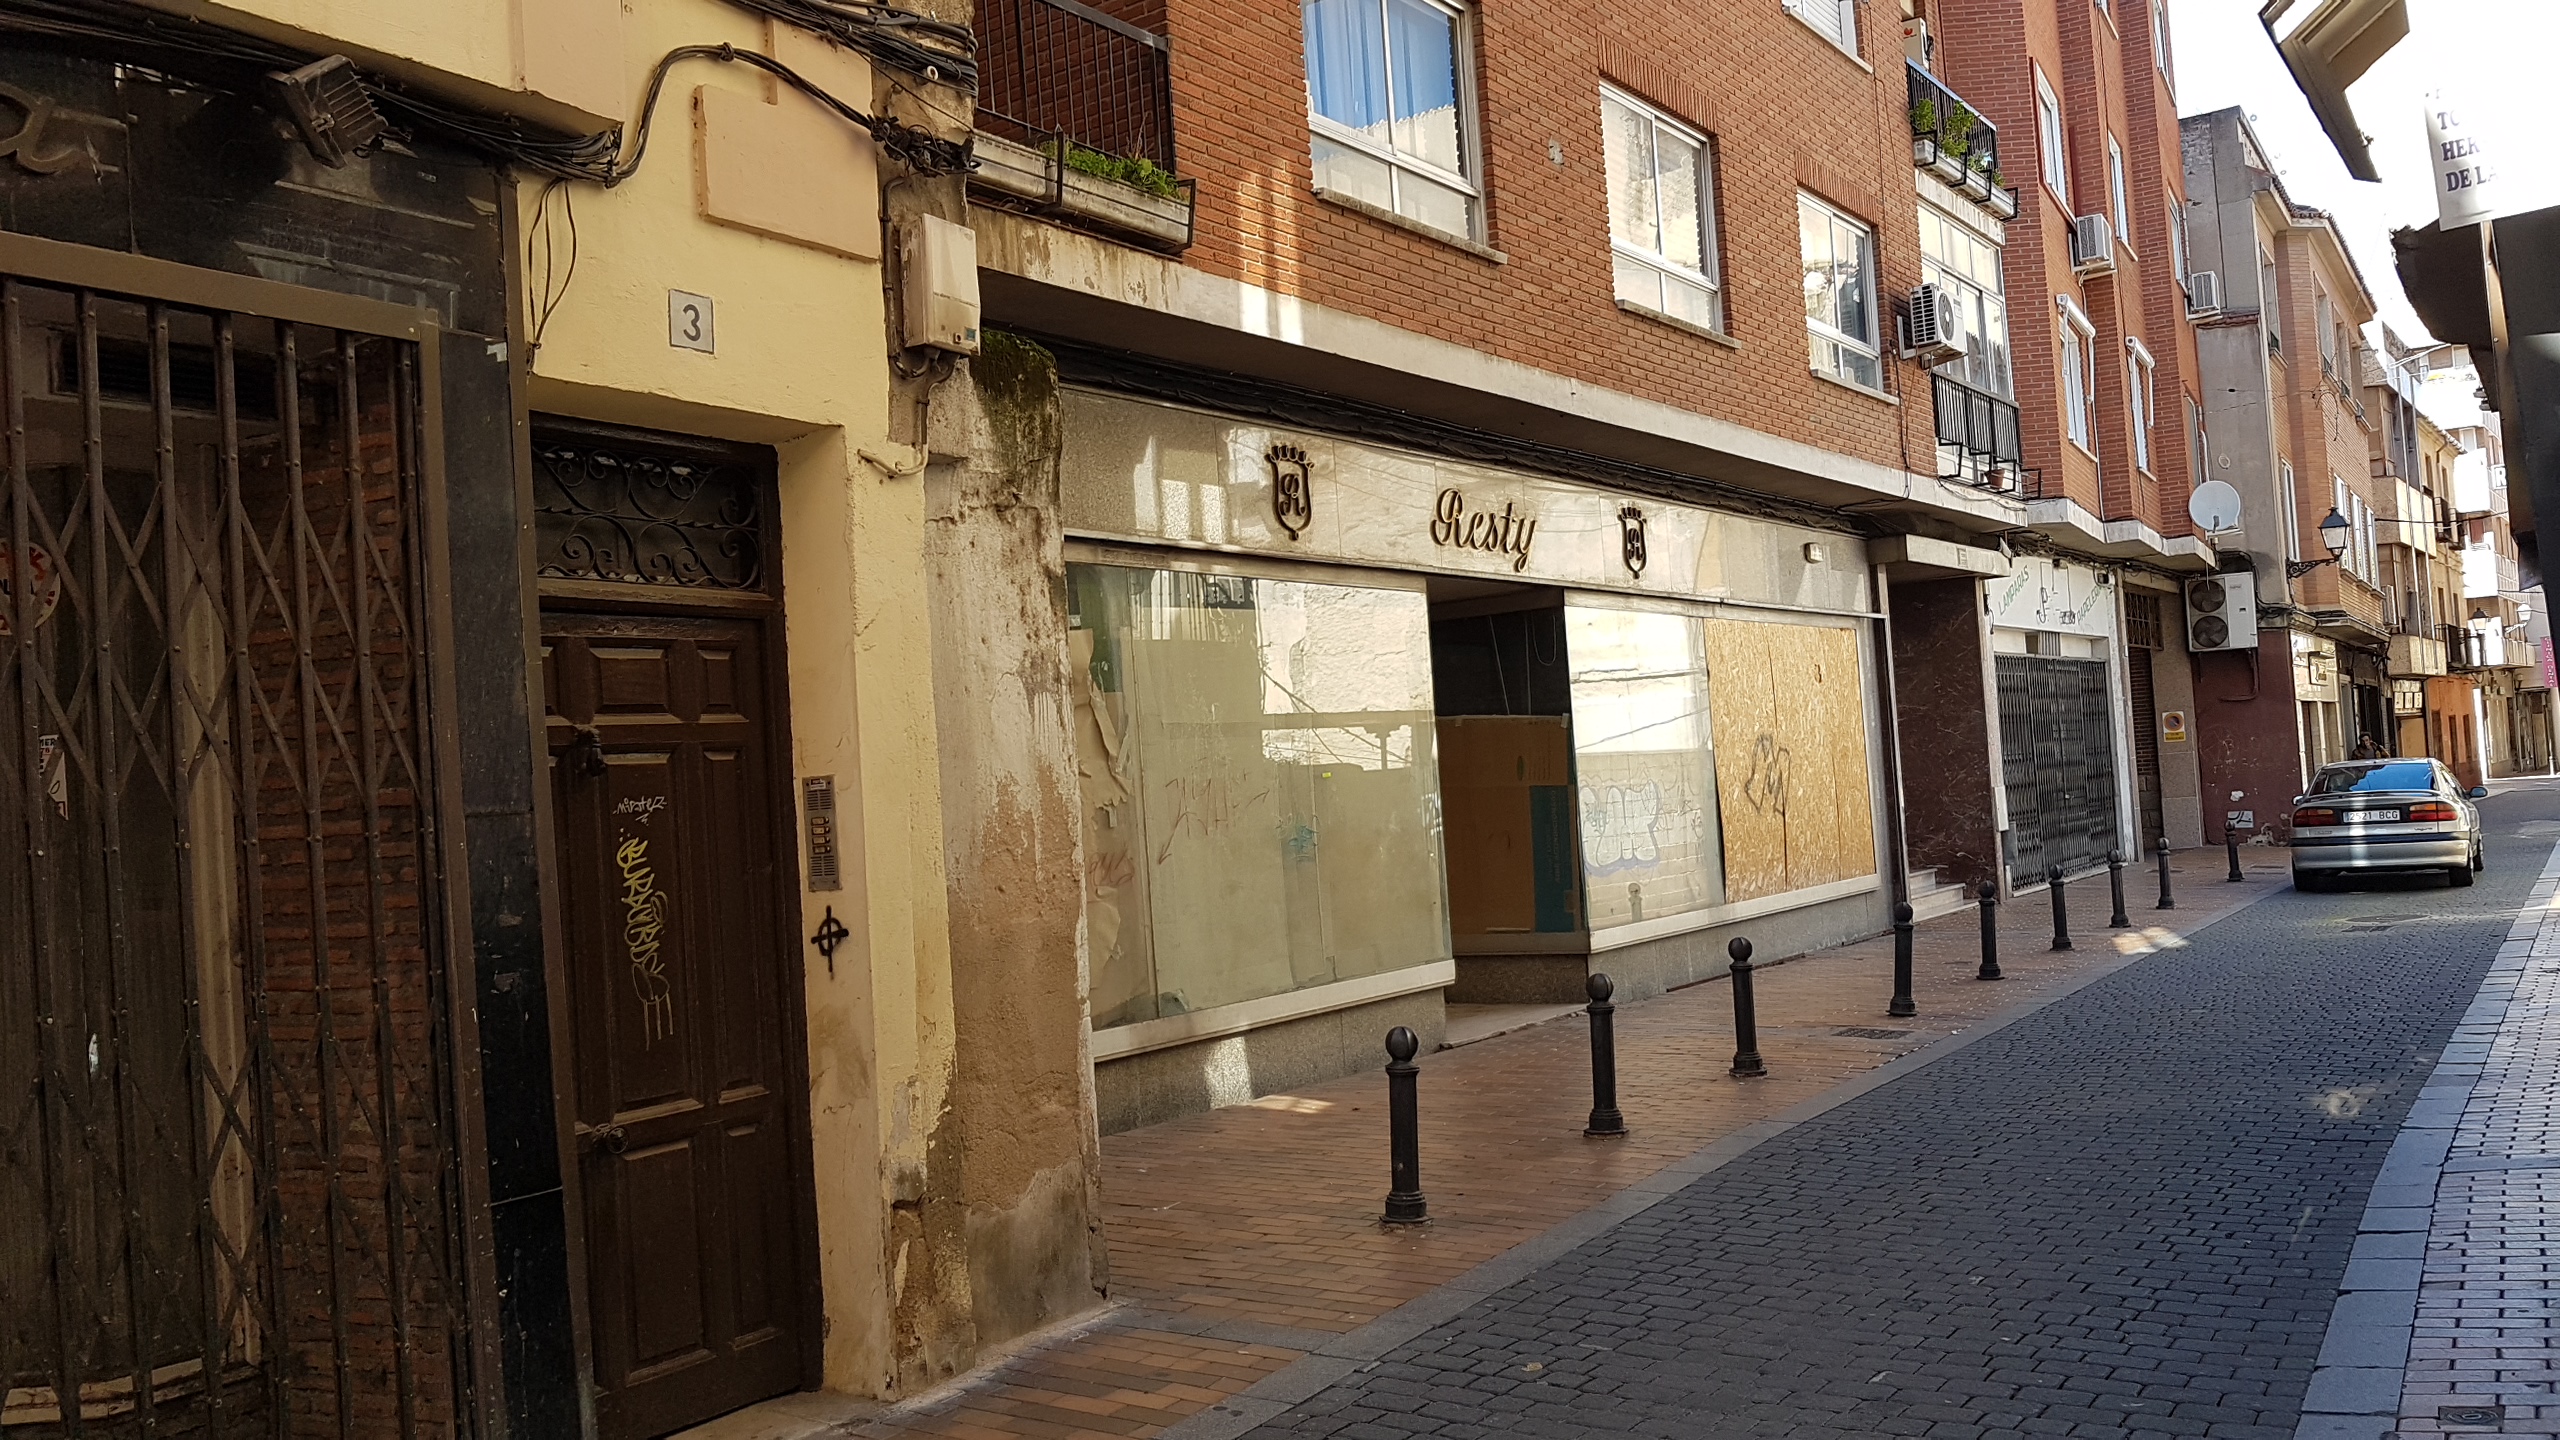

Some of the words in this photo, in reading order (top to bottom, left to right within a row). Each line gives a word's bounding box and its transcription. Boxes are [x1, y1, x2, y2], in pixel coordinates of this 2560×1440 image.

[2446, 168, 2472, 192] DE
[683, 304, 701, 342] 3
[1429, 487, 1537, 573] Resty
[1998, 564, 2030, 615] LAMPARAS
[2349, 811, 2372, 821] 2521
[2378, 810, 2398, 820] BCG
